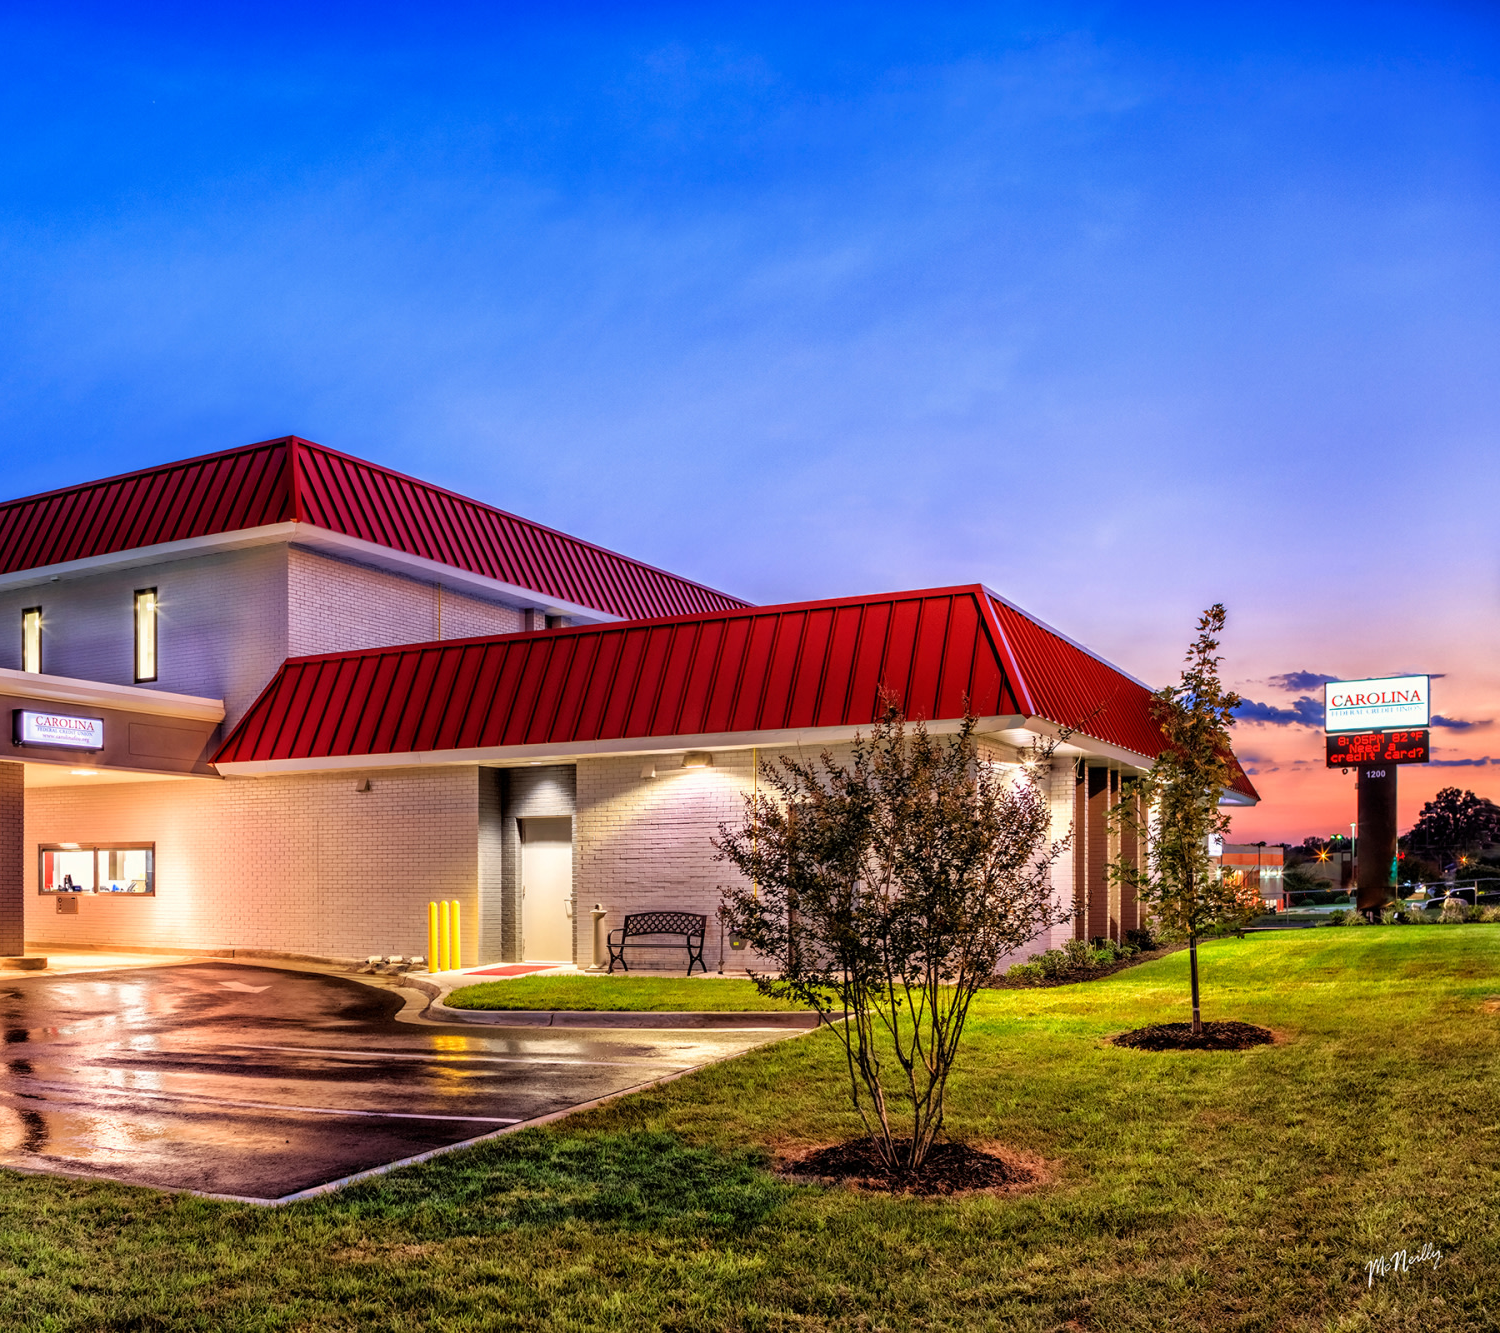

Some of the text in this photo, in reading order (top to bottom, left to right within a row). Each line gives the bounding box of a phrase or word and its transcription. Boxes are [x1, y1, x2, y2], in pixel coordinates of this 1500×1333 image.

[1331, 690, 1421, 707] CAROLINA
[36, 716, 94, 731] CAROLINA
[1330, 747, 1424, 763] credit card?
[1349, 743, 1396, 754] Need a
[1366, 770, 1386, 778] 1200
